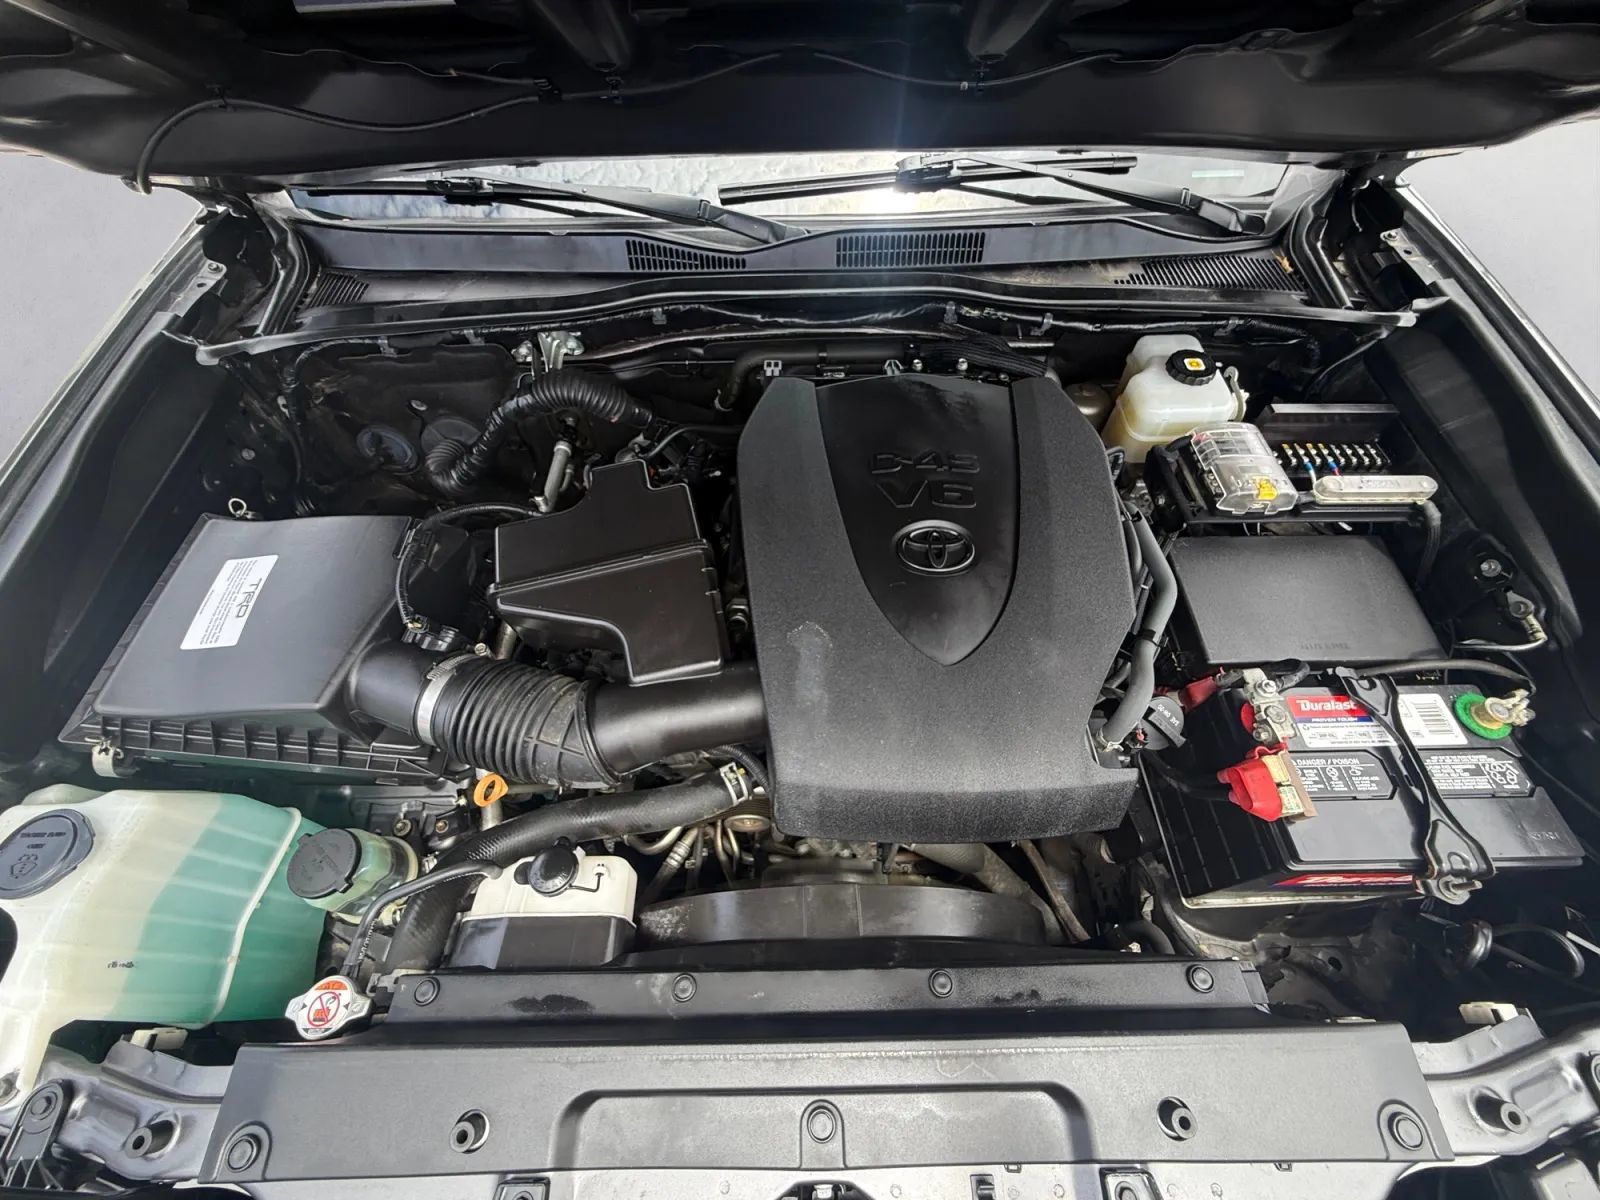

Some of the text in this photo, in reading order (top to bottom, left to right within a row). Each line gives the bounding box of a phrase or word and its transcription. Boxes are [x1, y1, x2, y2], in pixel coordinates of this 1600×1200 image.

[870, 452, 980, 474] D-4S
[873, 479, 978, 508] V6
[236, 577, 262, 618] TRD
[1296, 700, 1357, 711] Duralast
[1170, 716, 1180, 727] SAE
[1296, 758, 1326, 766] DANGER
